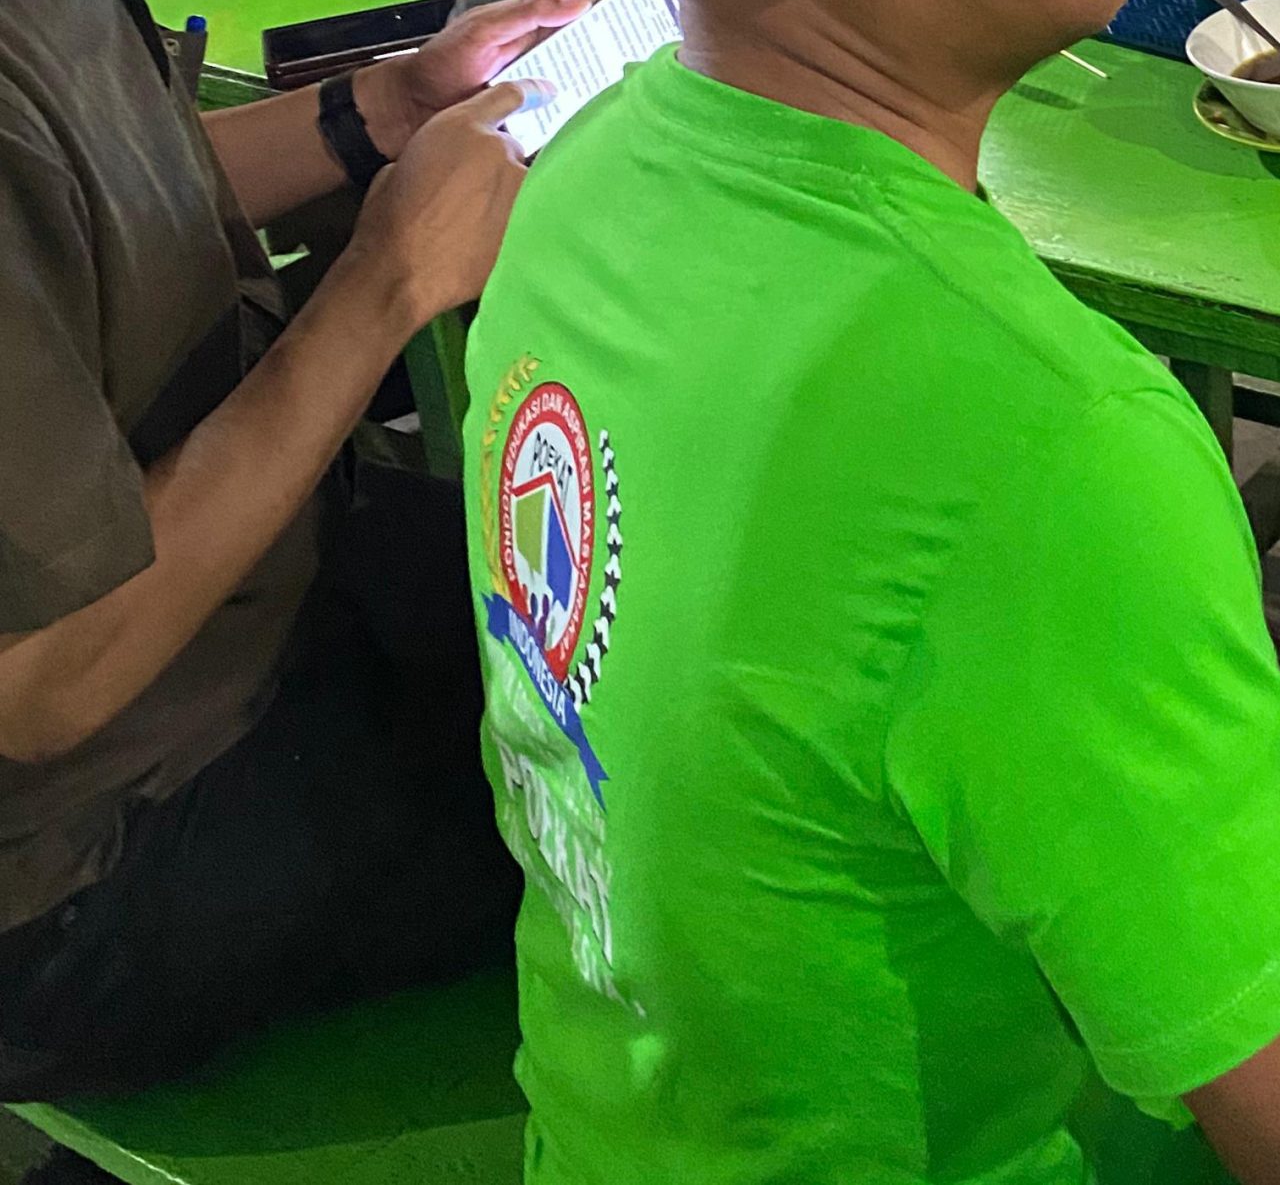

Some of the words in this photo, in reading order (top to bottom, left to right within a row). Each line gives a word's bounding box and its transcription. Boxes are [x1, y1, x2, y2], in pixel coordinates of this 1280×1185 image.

[506, 396, 541, 472] EDUKASI
[541, 392, 564, 415] DAN
[561, 400, 592, 495] ASPIRASI
[501, 476, 515, 582] PONDOK
[558, 502, 593, 662] MASYARAKAT
[508, 607, 568, 726] INDONESIA
